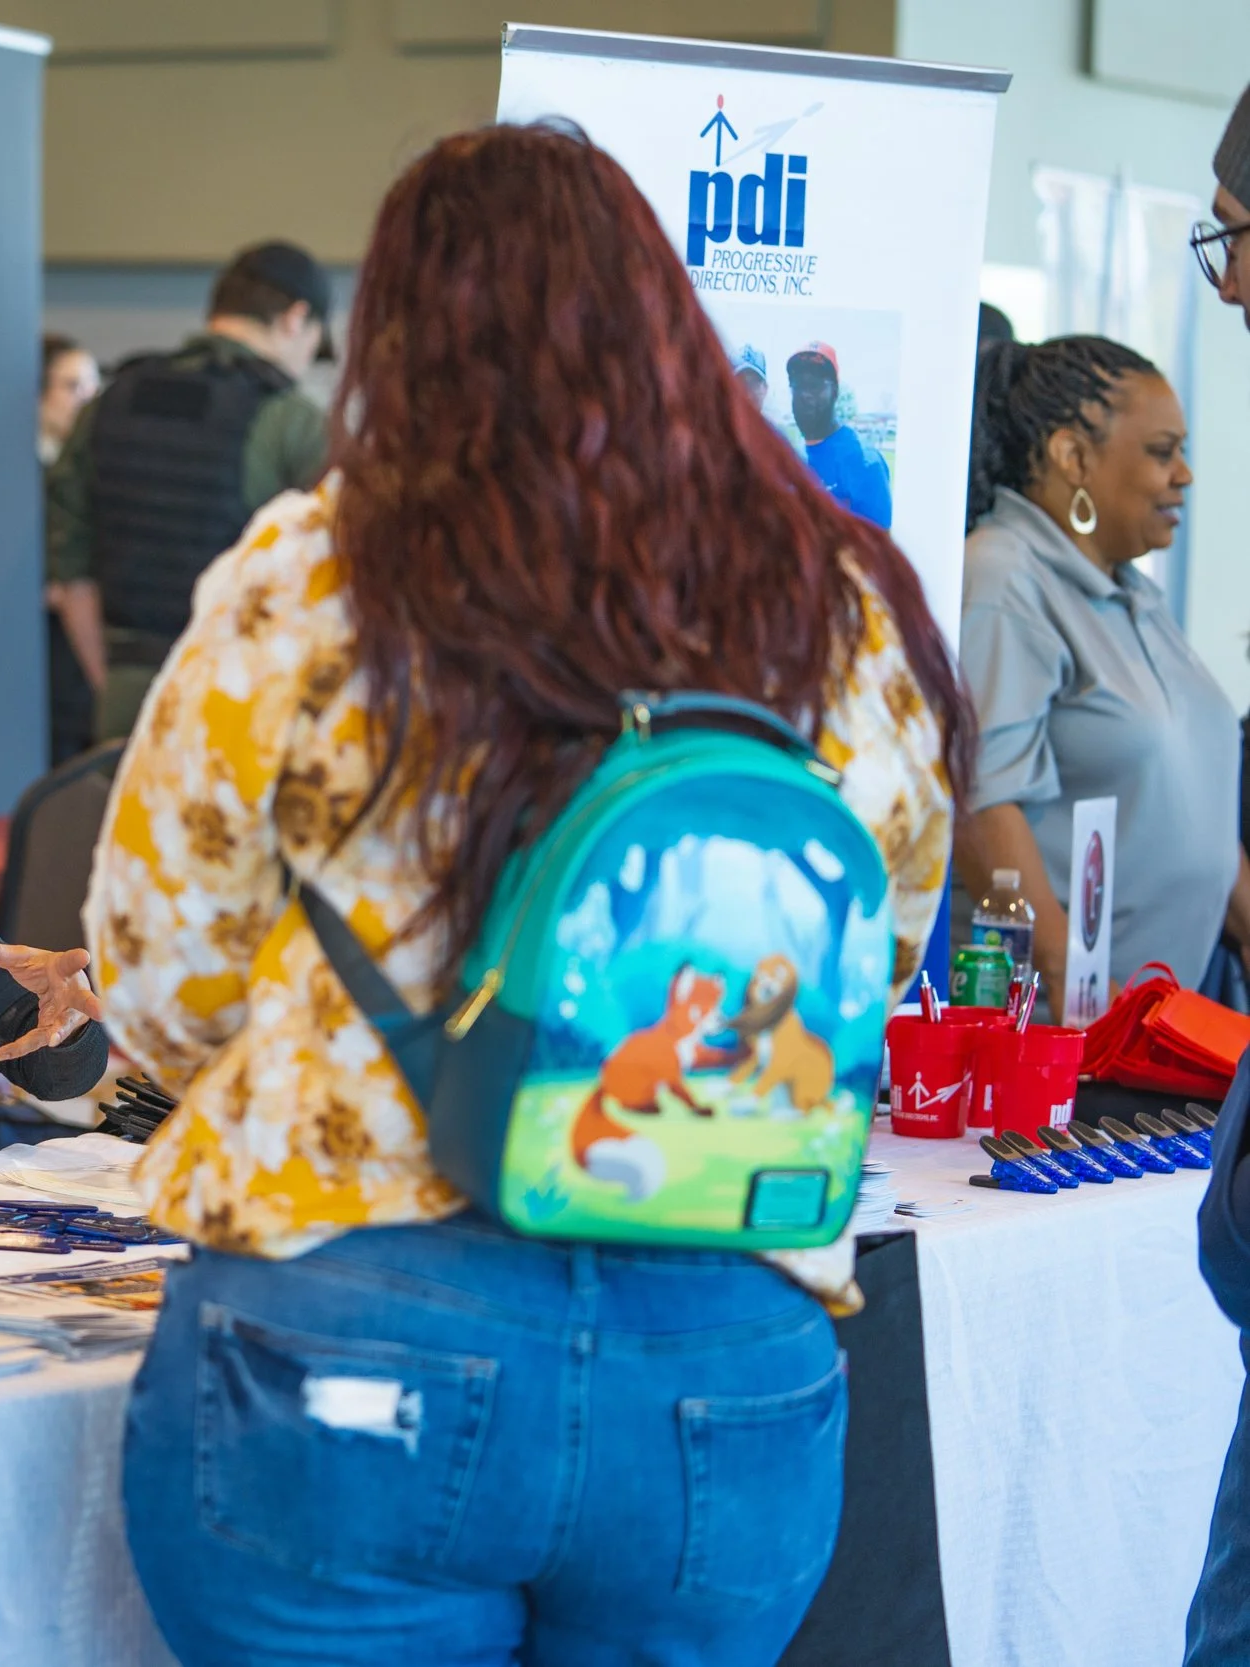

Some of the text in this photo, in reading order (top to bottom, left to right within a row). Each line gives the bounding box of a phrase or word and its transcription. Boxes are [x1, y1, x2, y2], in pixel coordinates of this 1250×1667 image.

[686, 153, 807, 266] pdi
[711, 249, 818, 275] PROGRESSIVE
[690, 269, 813, 296] DIRECTIONS, INC.
[1049, 1098, 1073, 1129] pd
